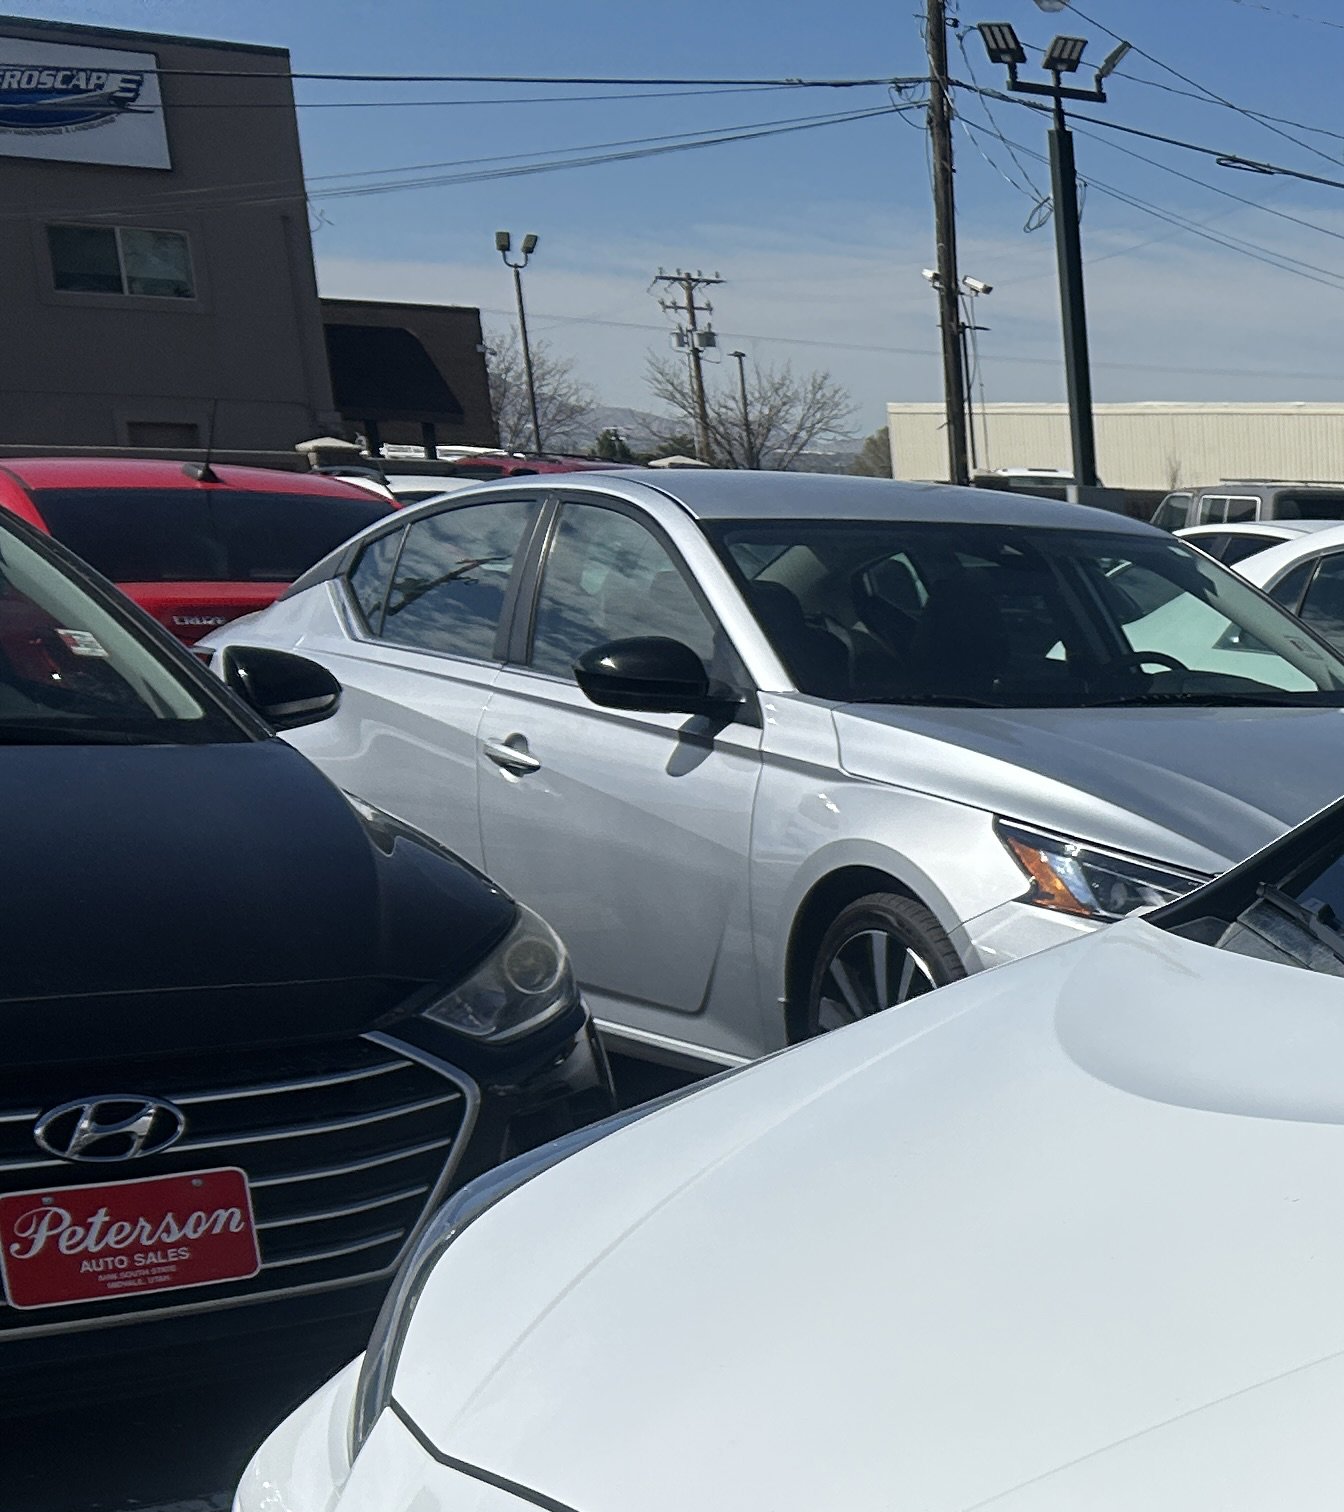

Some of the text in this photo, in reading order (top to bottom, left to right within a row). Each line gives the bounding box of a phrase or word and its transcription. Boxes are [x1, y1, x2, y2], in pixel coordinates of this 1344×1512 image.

[0, 70, 144, 101] ROSCAPE
[9, 1205, 245, 1260] Peterson
[80, 1247, 191, 1273] AUTO SALES
